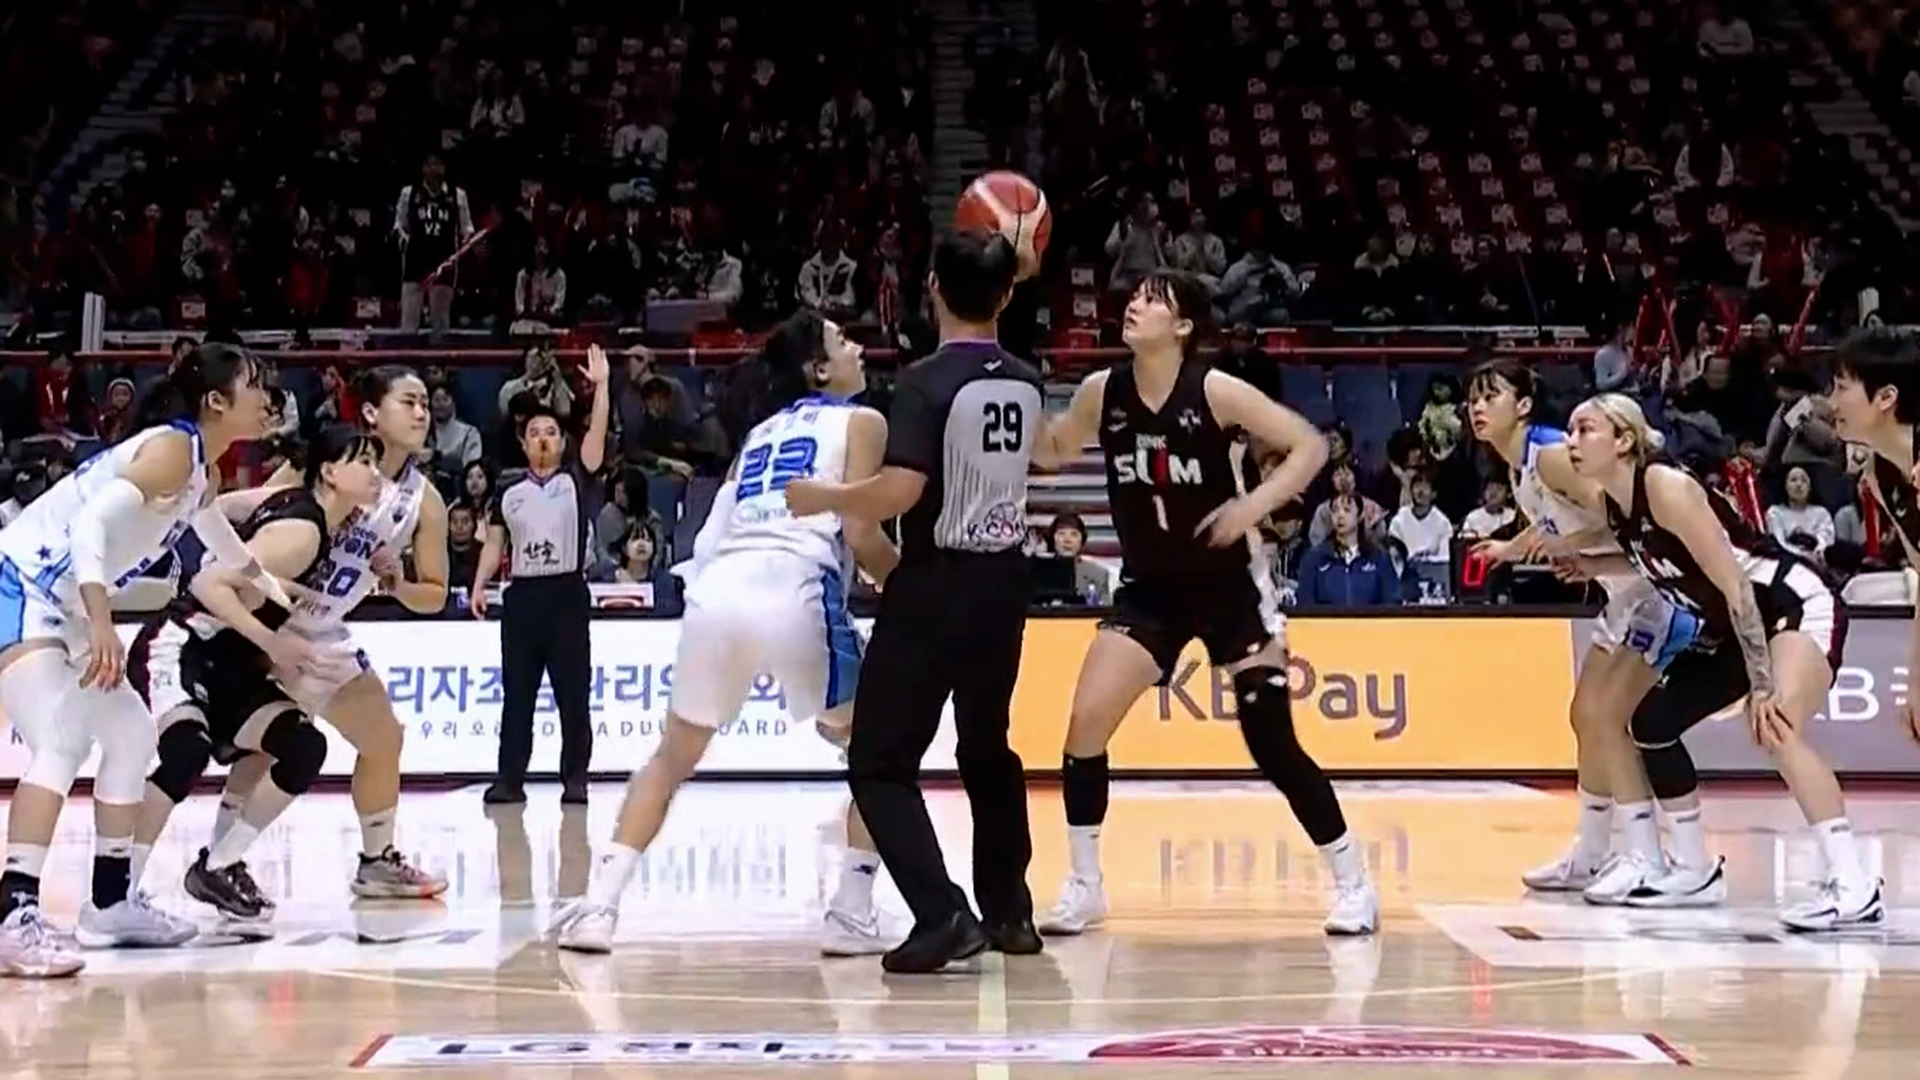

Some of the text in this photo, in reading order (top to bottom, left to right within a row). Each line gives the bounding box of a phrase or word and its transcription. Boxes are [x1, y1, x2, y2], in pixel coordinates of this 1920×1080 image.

[983, 402, 1022, 452] 29
[736, 437, 818, 503] 22
[1114, 449, 1203, 486] SUM
[1153, 494, 1169, 531] 1
[1287, 656, 1407, 740] Pay
[718, 719, 787, 737] OARD
